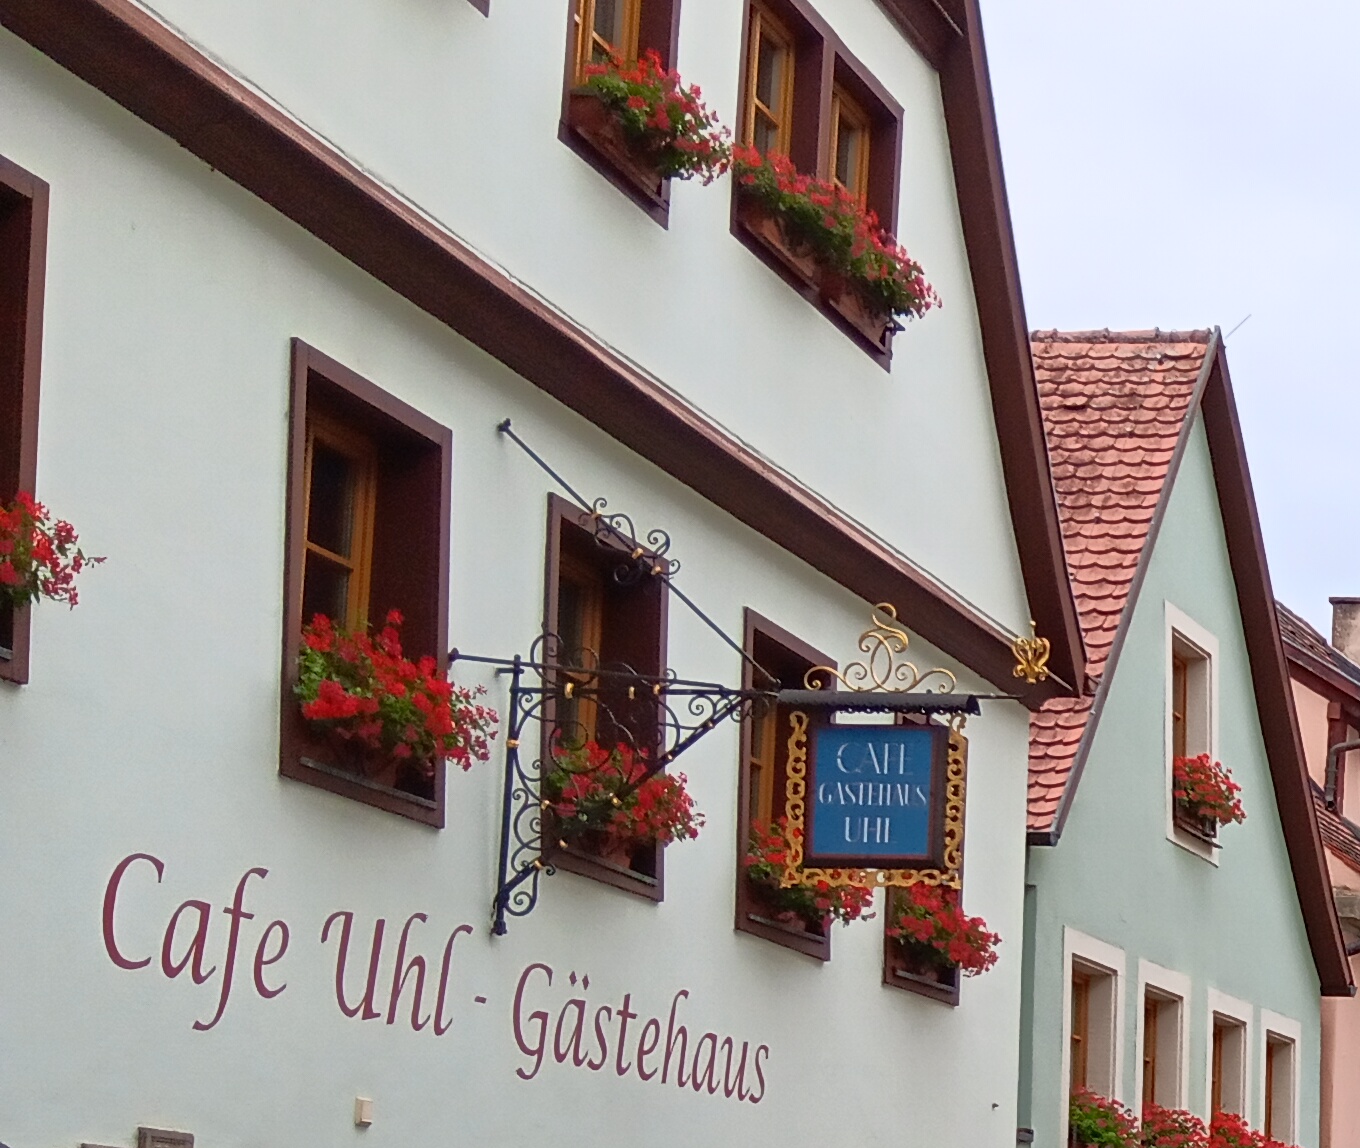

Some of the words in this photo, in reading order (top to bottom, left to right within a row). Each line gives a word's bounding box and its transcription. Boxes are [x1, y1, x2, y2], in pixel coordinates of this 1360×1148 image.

[844, 816, 898, 844] UHL
[102, 852, 290, 1031] Cafe
[321, 910, 473, 1036] Uhl
[512, 962, 771, 1105] Gästehaus
